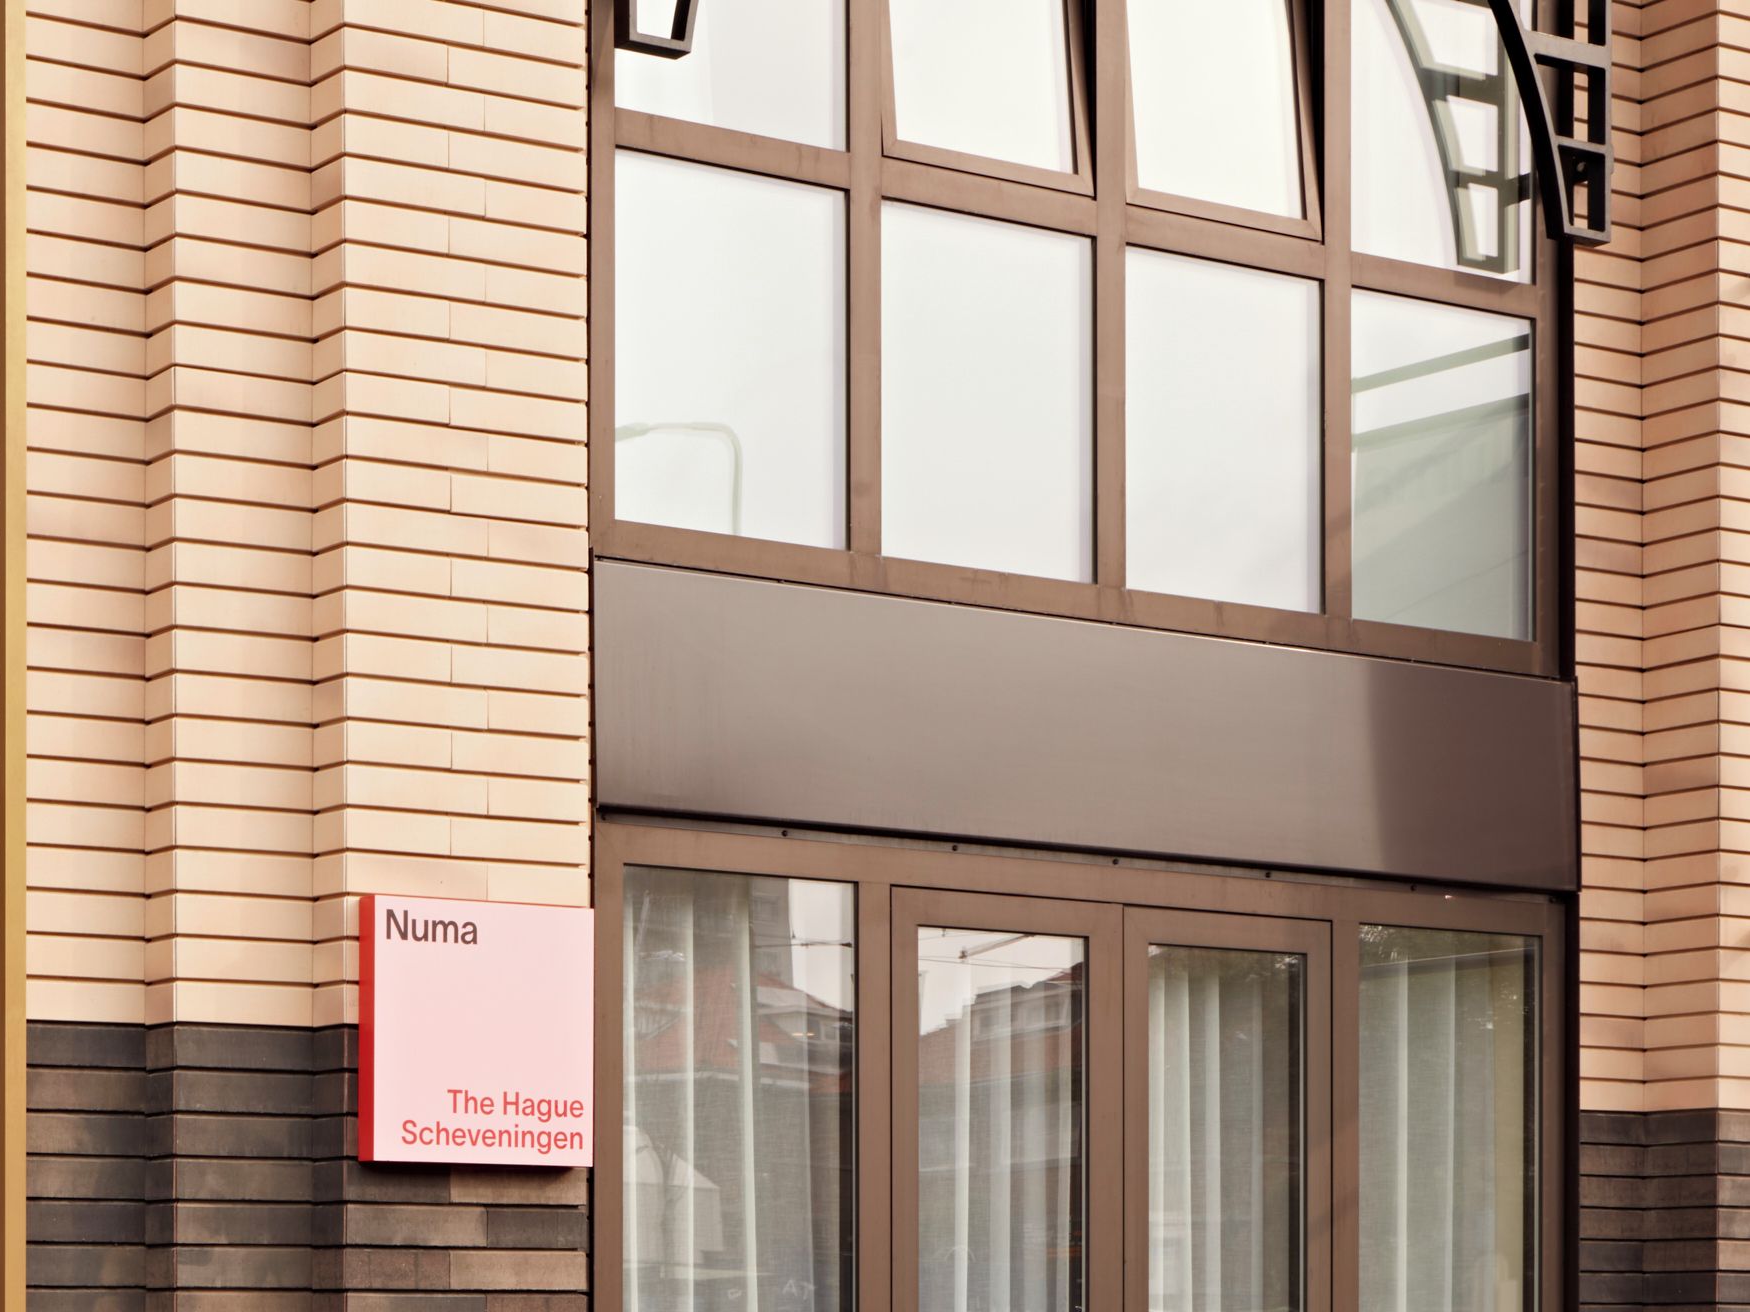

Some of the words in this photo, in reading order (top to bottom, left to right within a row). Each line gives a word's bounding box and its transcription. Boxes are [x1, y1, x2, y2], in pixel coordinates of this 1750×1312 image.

[385, 908, 478, 945] Numa
[447, 1089, 495, 1114] The
[503, 1091, 584, 1123] Hague
[401, 1119, 584, 1155] Scheveningen
